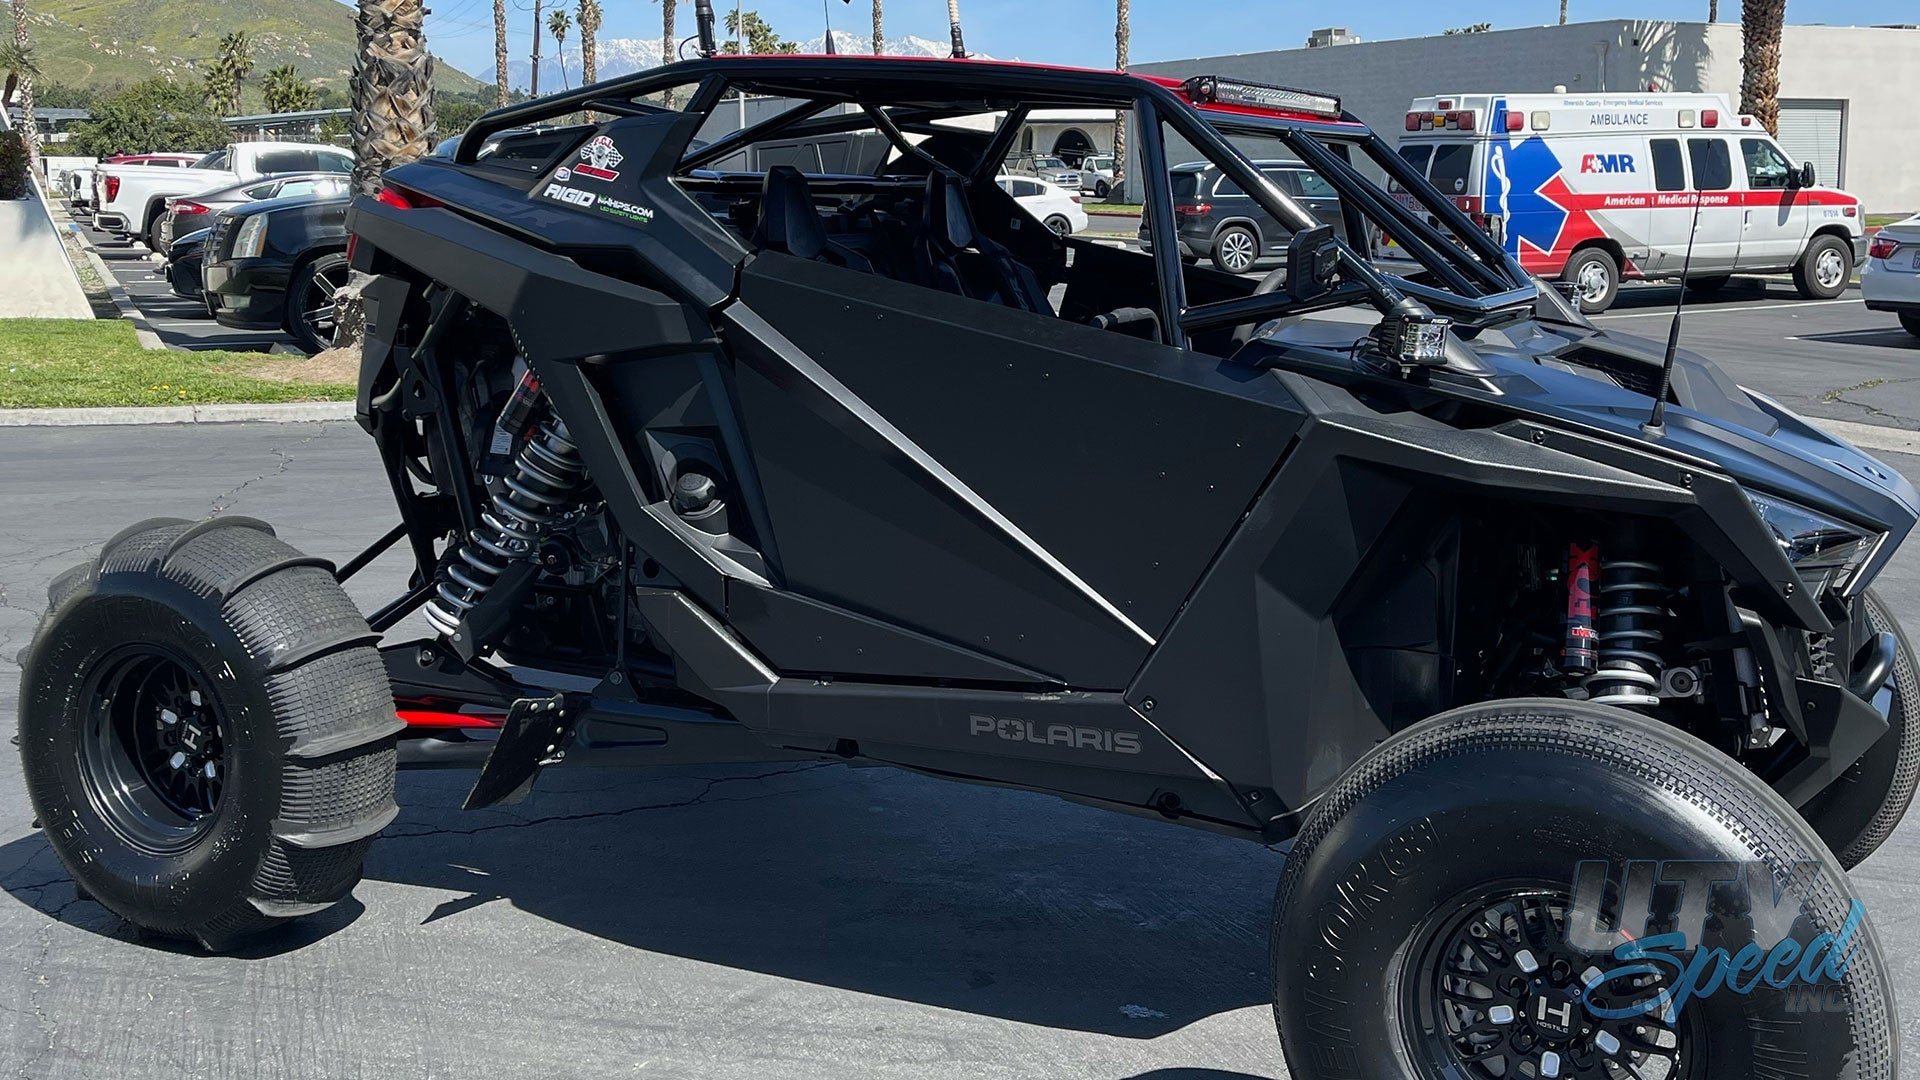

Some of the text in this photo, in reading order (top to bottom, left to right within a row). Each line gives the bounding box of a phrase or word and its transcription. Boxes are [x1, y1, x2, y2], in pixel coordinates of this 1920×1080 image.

[1585, 99, 1601, 107] County
[1603, 99, 1627, 107] Emergency
[1590, 113, 1648, 125] AMBULANCE
[1580, 154, 1636, 173] AMR
[543, 183, 596, 207] RIGID
[1604, 194, 1646, 206] American
[1657, 193, 1690, 205] Medical
[969, 714, 1143, 754] POLARIS
